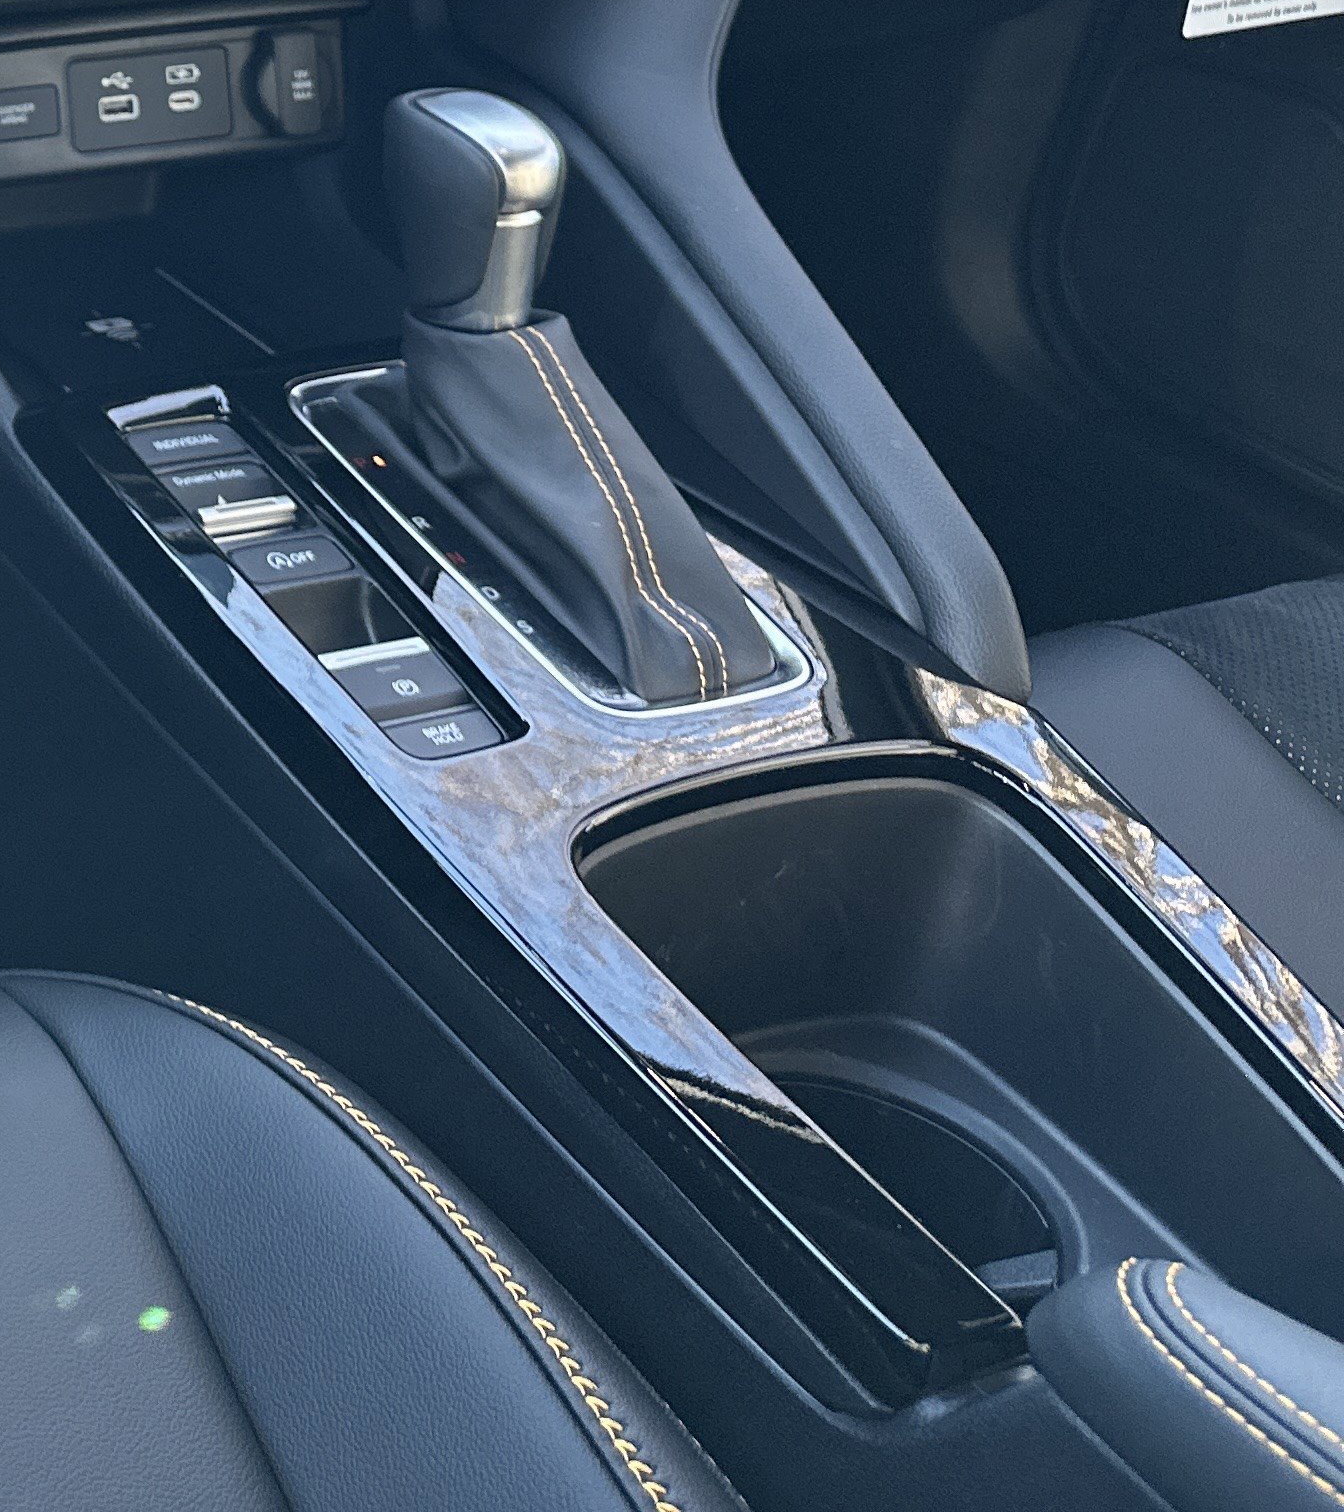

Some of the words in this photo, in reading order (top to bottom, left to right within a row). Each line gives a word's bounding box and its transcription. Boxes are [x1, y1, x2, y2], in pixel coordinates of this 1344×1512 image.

[412, 515, 433, 530] R
[481, 585, 501, 601] D
[515, 618, 535, 636] S
